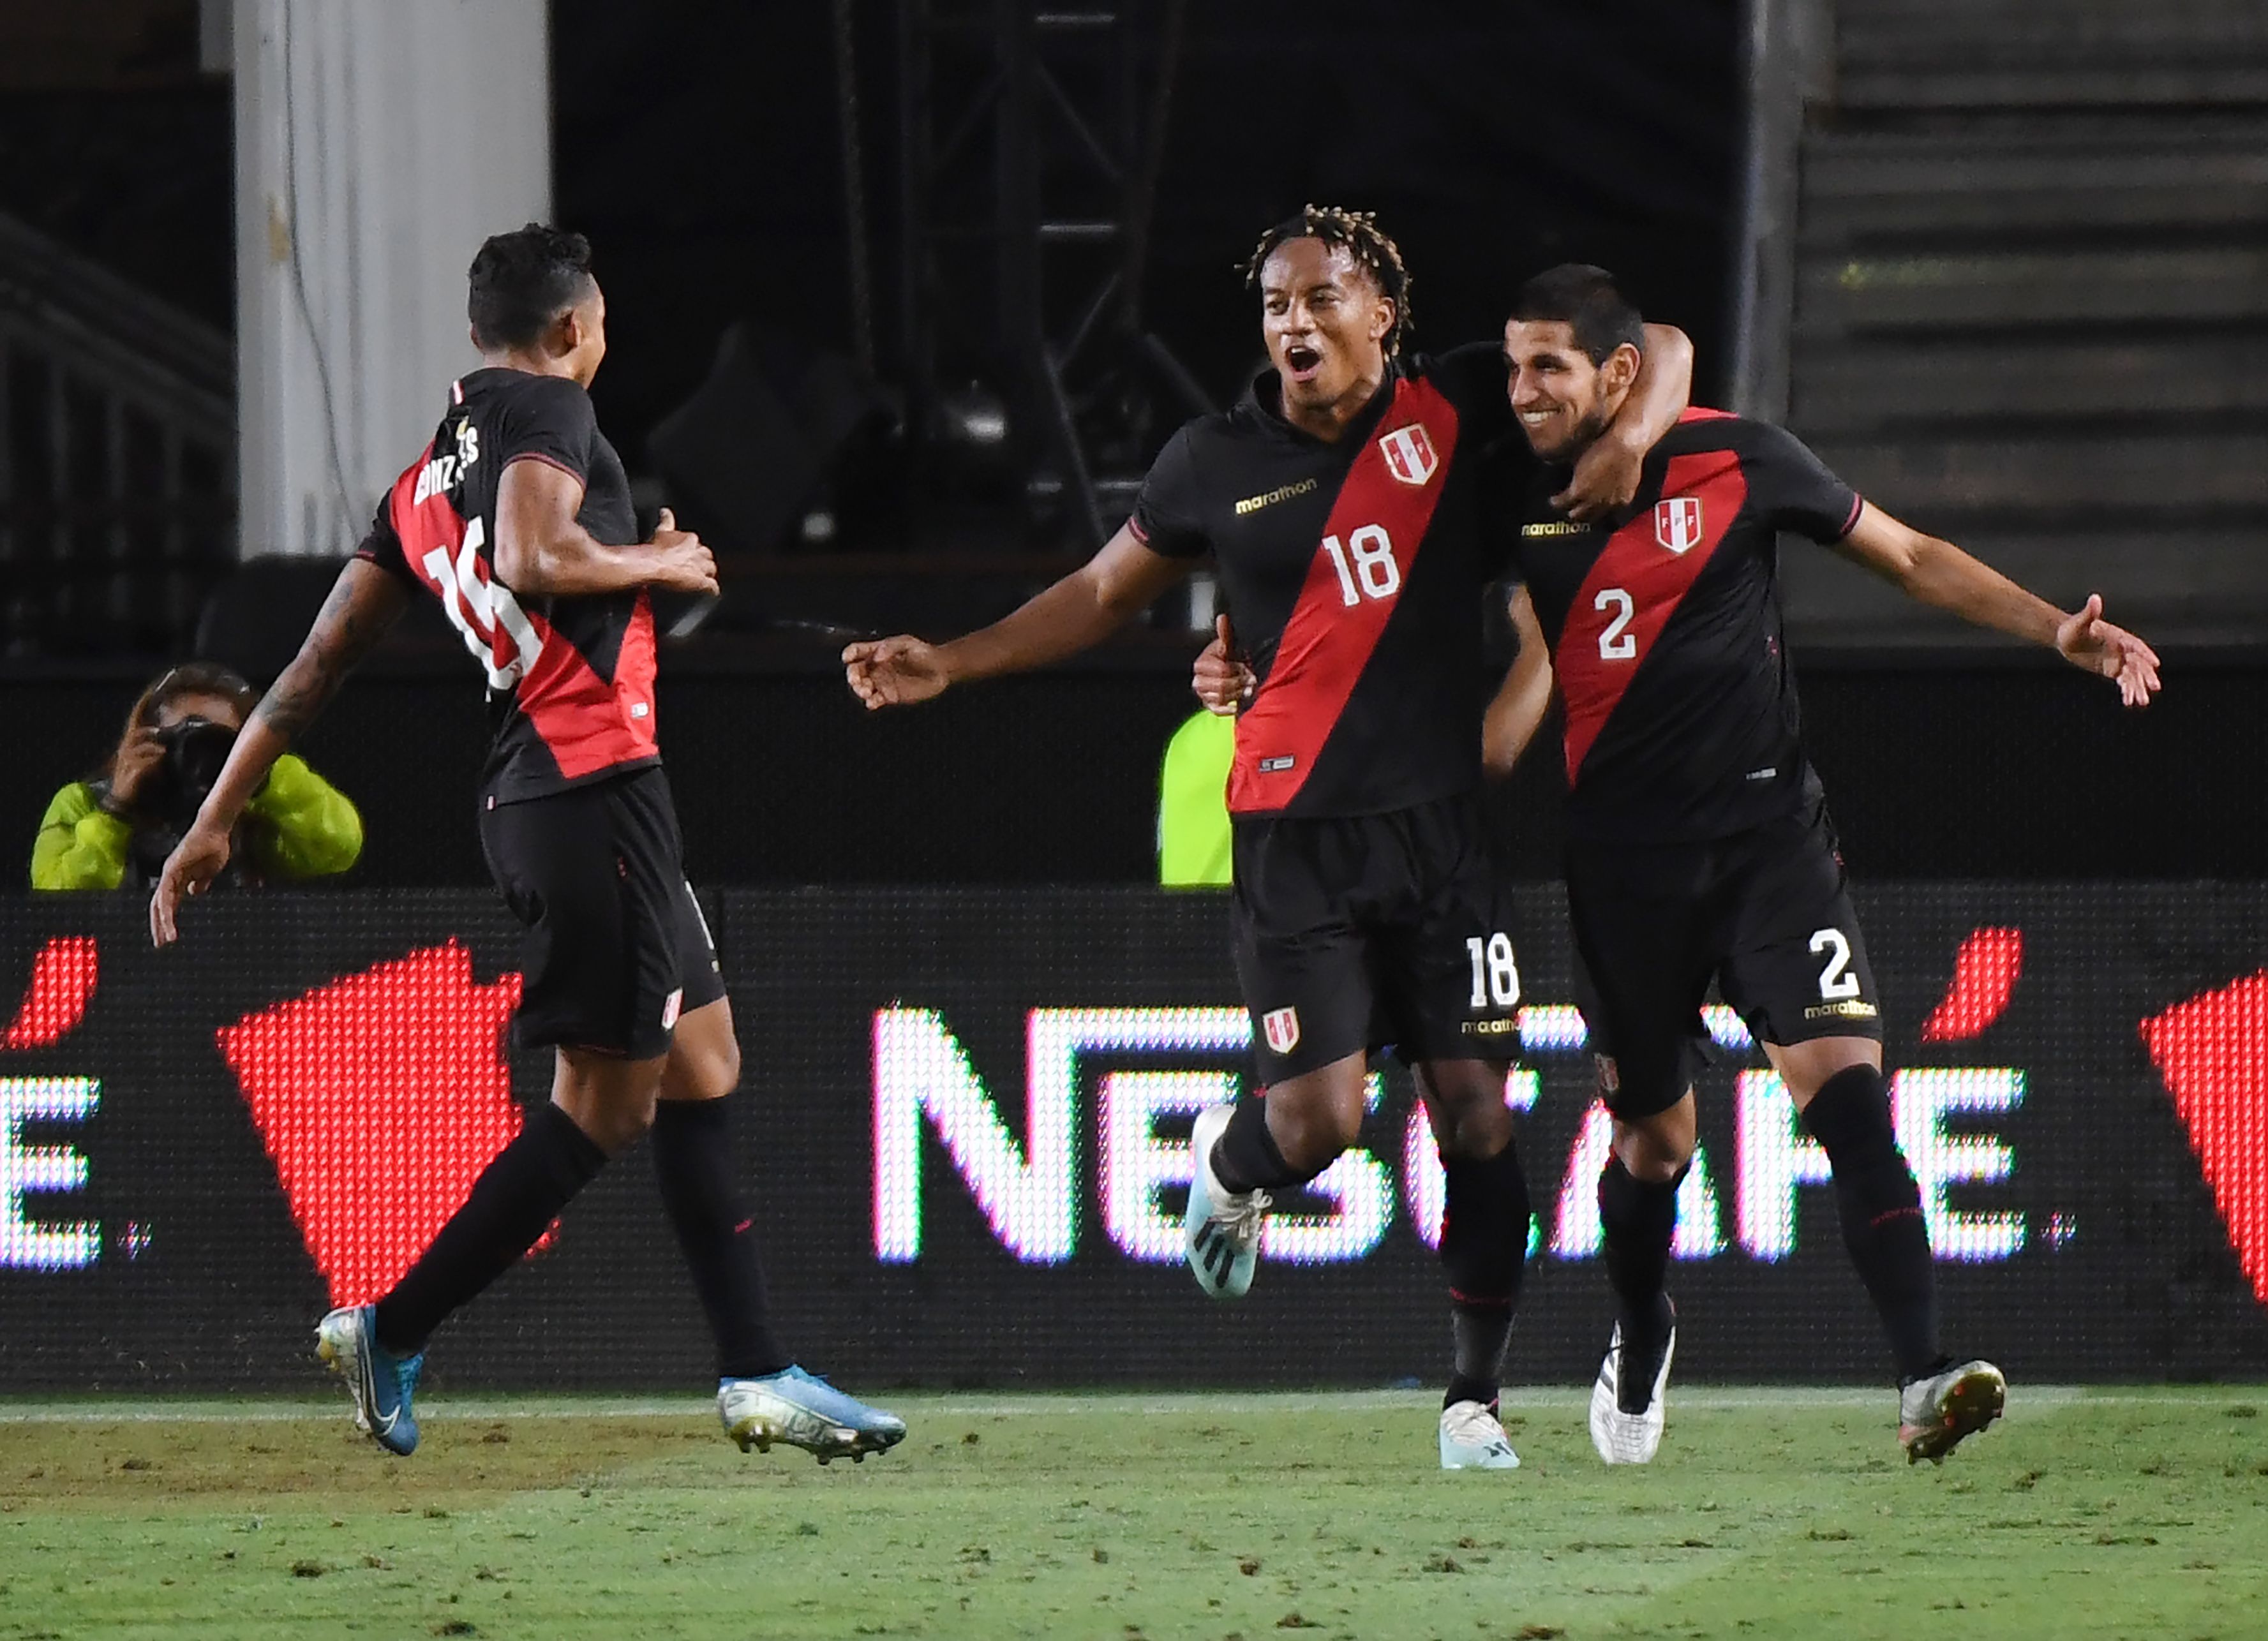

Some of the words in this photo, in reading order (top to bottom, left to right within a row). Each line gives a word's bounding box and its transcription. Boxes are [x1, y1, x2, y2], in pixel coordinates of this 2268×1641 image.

[1235, 477, 1318, 514] marathon
[1321, 523, 1401, 607] 18
[1594, 588, 1636, 660] 2
[1466, 932, 1519, 1007] 18
[1809, 928, 1860, 999] 2
